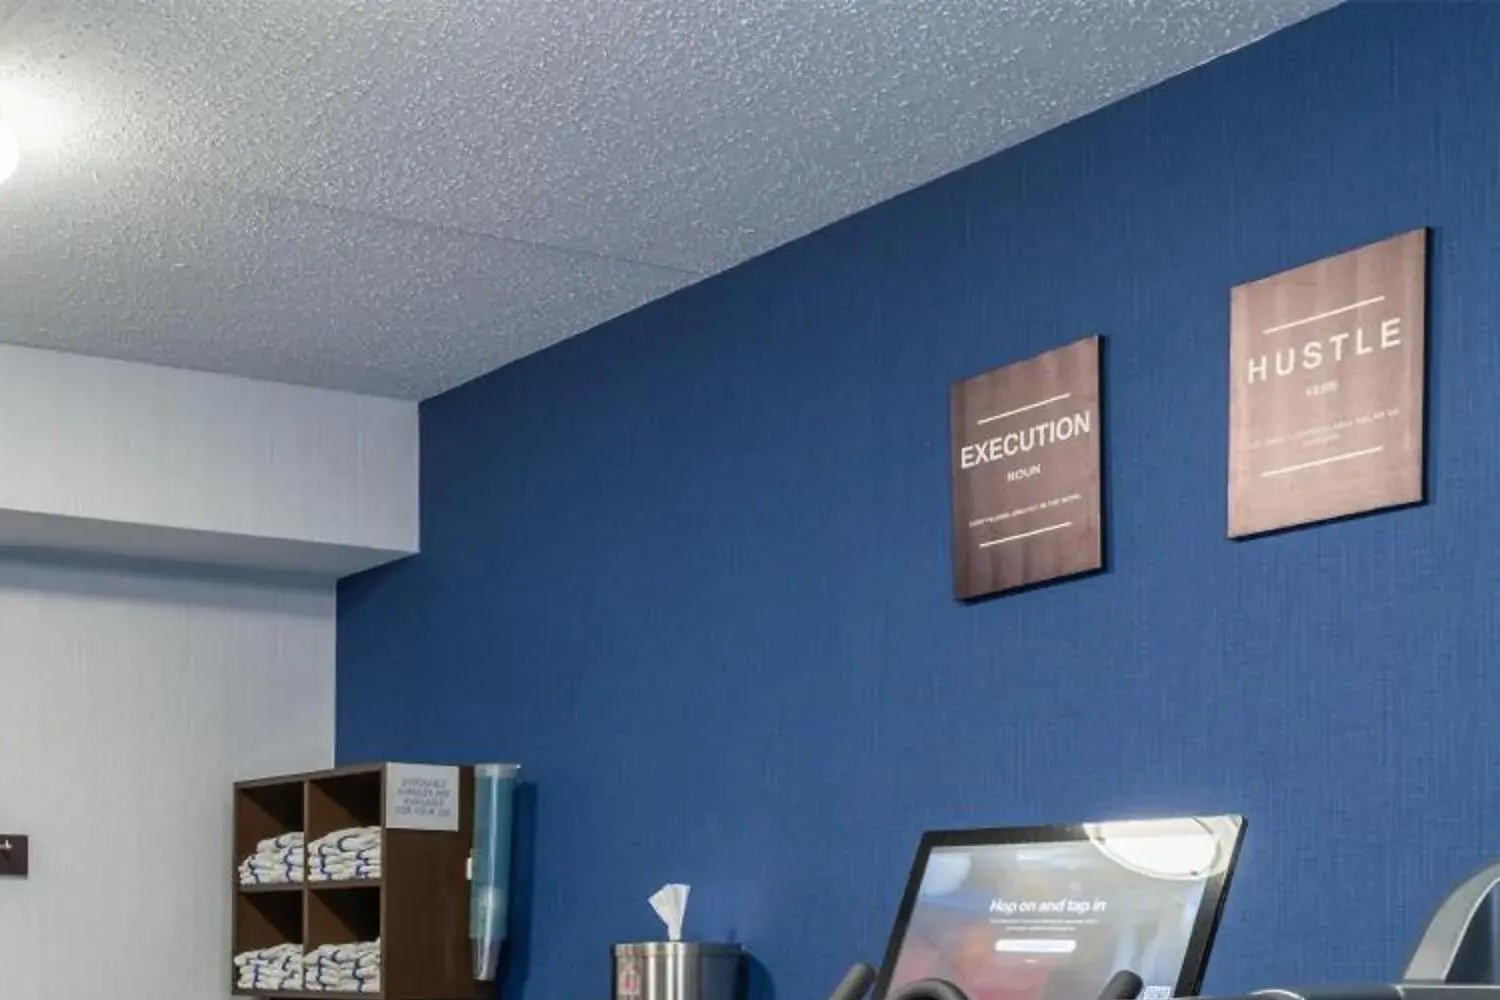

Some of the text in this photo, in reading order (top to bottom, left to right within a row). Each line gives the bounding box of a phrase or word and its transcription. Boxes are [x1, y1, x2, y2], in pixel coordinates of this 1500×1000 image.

[1248, 317, 1402, 385] HUSTLE
[960, 409, 1091, 469] EXECUTION
[1006, 463, 1042, 482] NOUN
[989, 897, 1107, 915] Hop on and tap in
